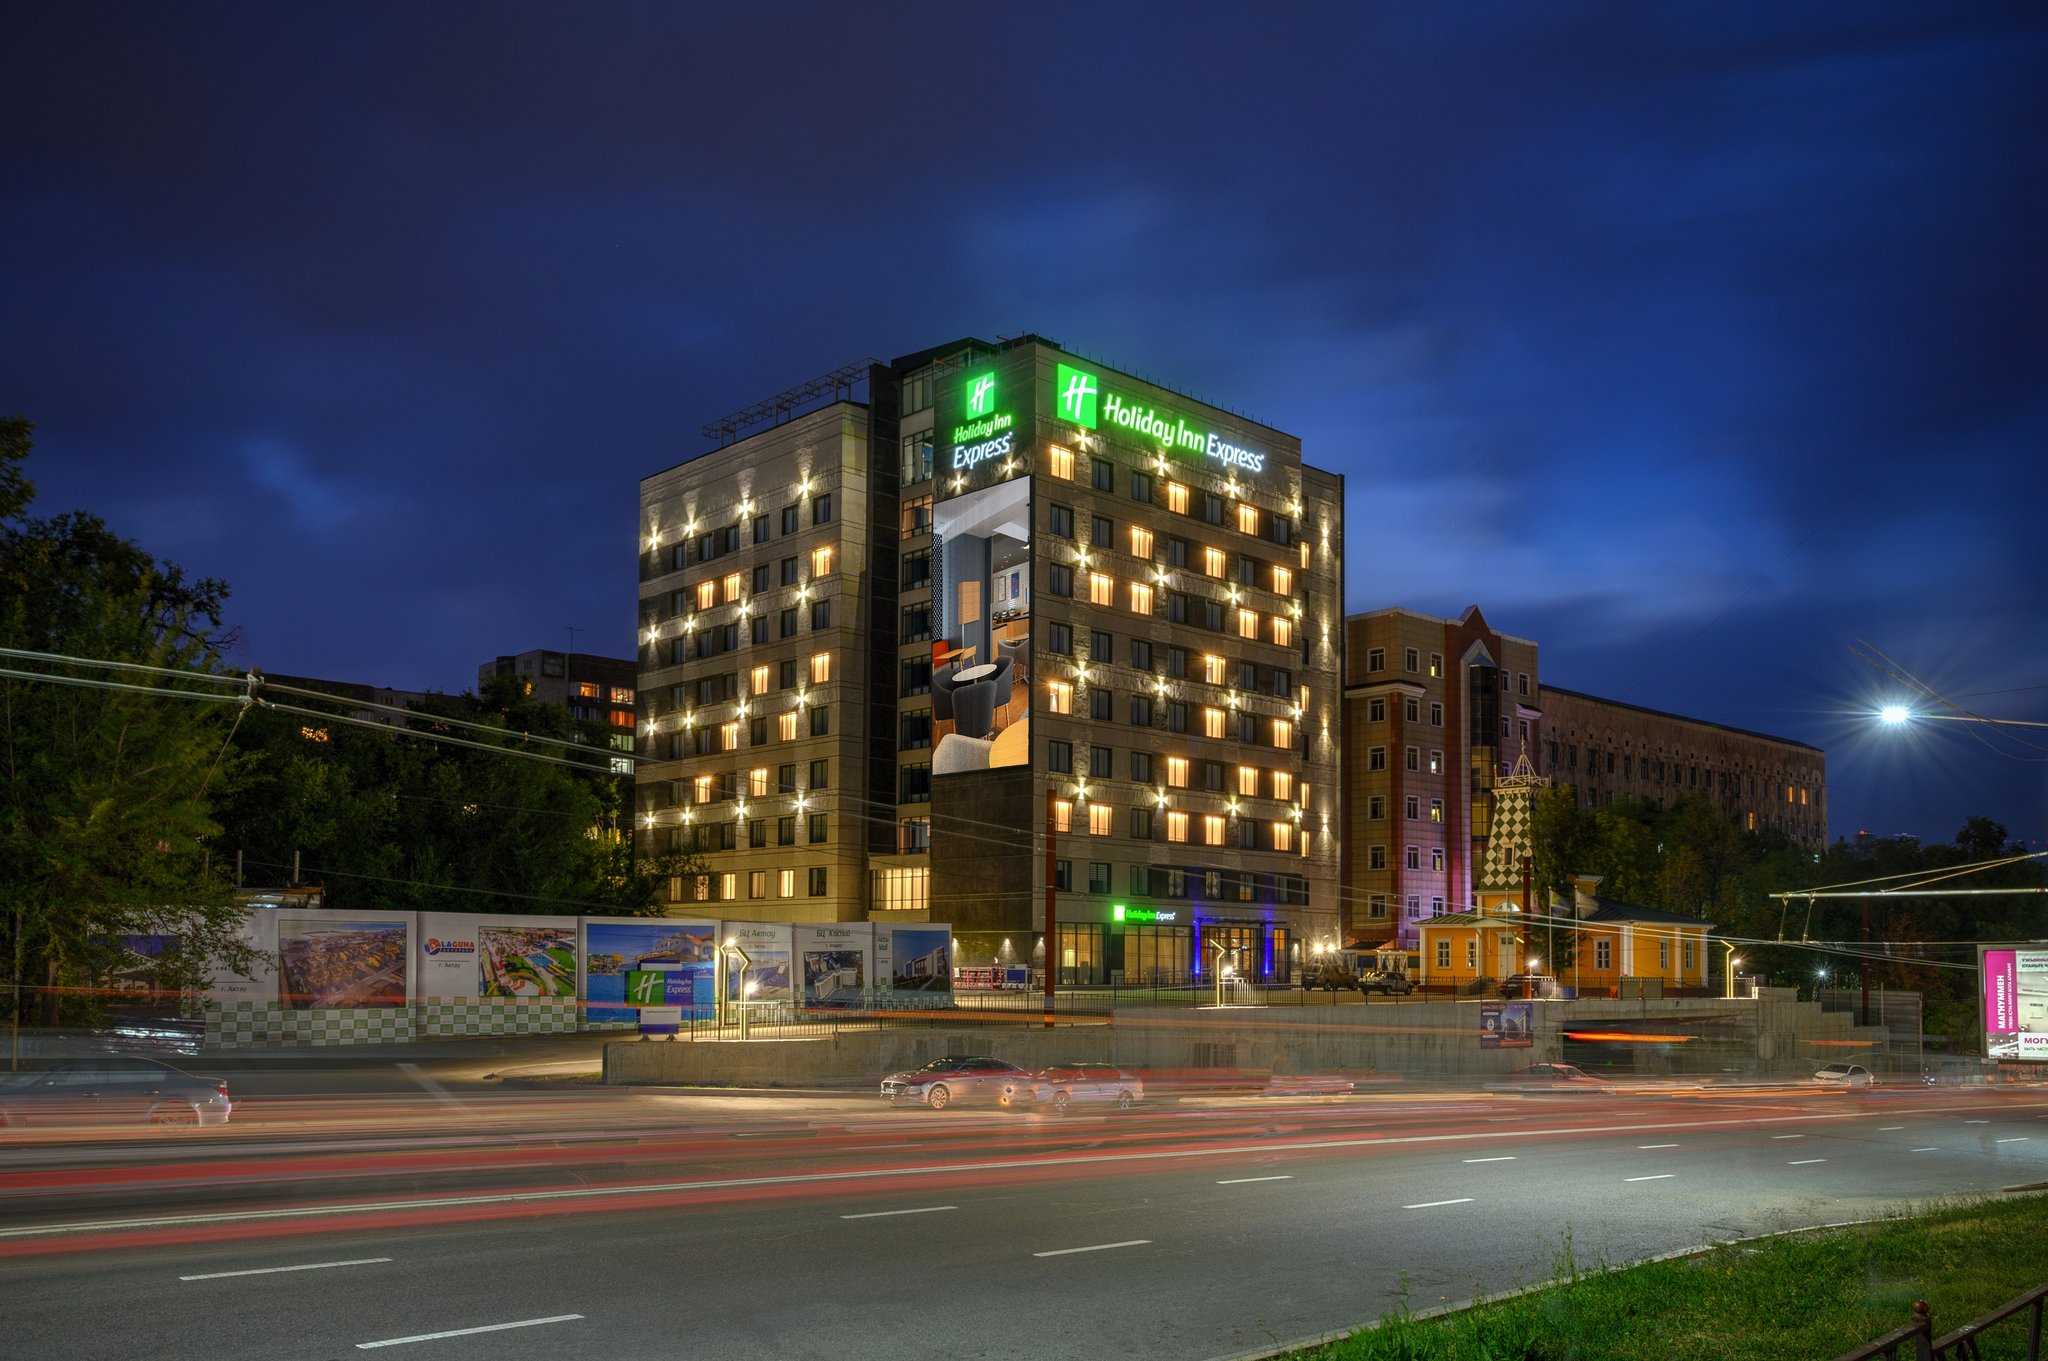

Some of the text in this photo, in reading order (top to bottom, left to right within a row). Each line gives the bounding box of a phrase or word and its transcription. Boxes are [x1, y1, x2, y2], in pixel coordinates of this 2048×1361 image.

[953, 413, 1013, 470] Holiday Inn Express
[1103, 393, 1264, 473] Holiday Inn Express
